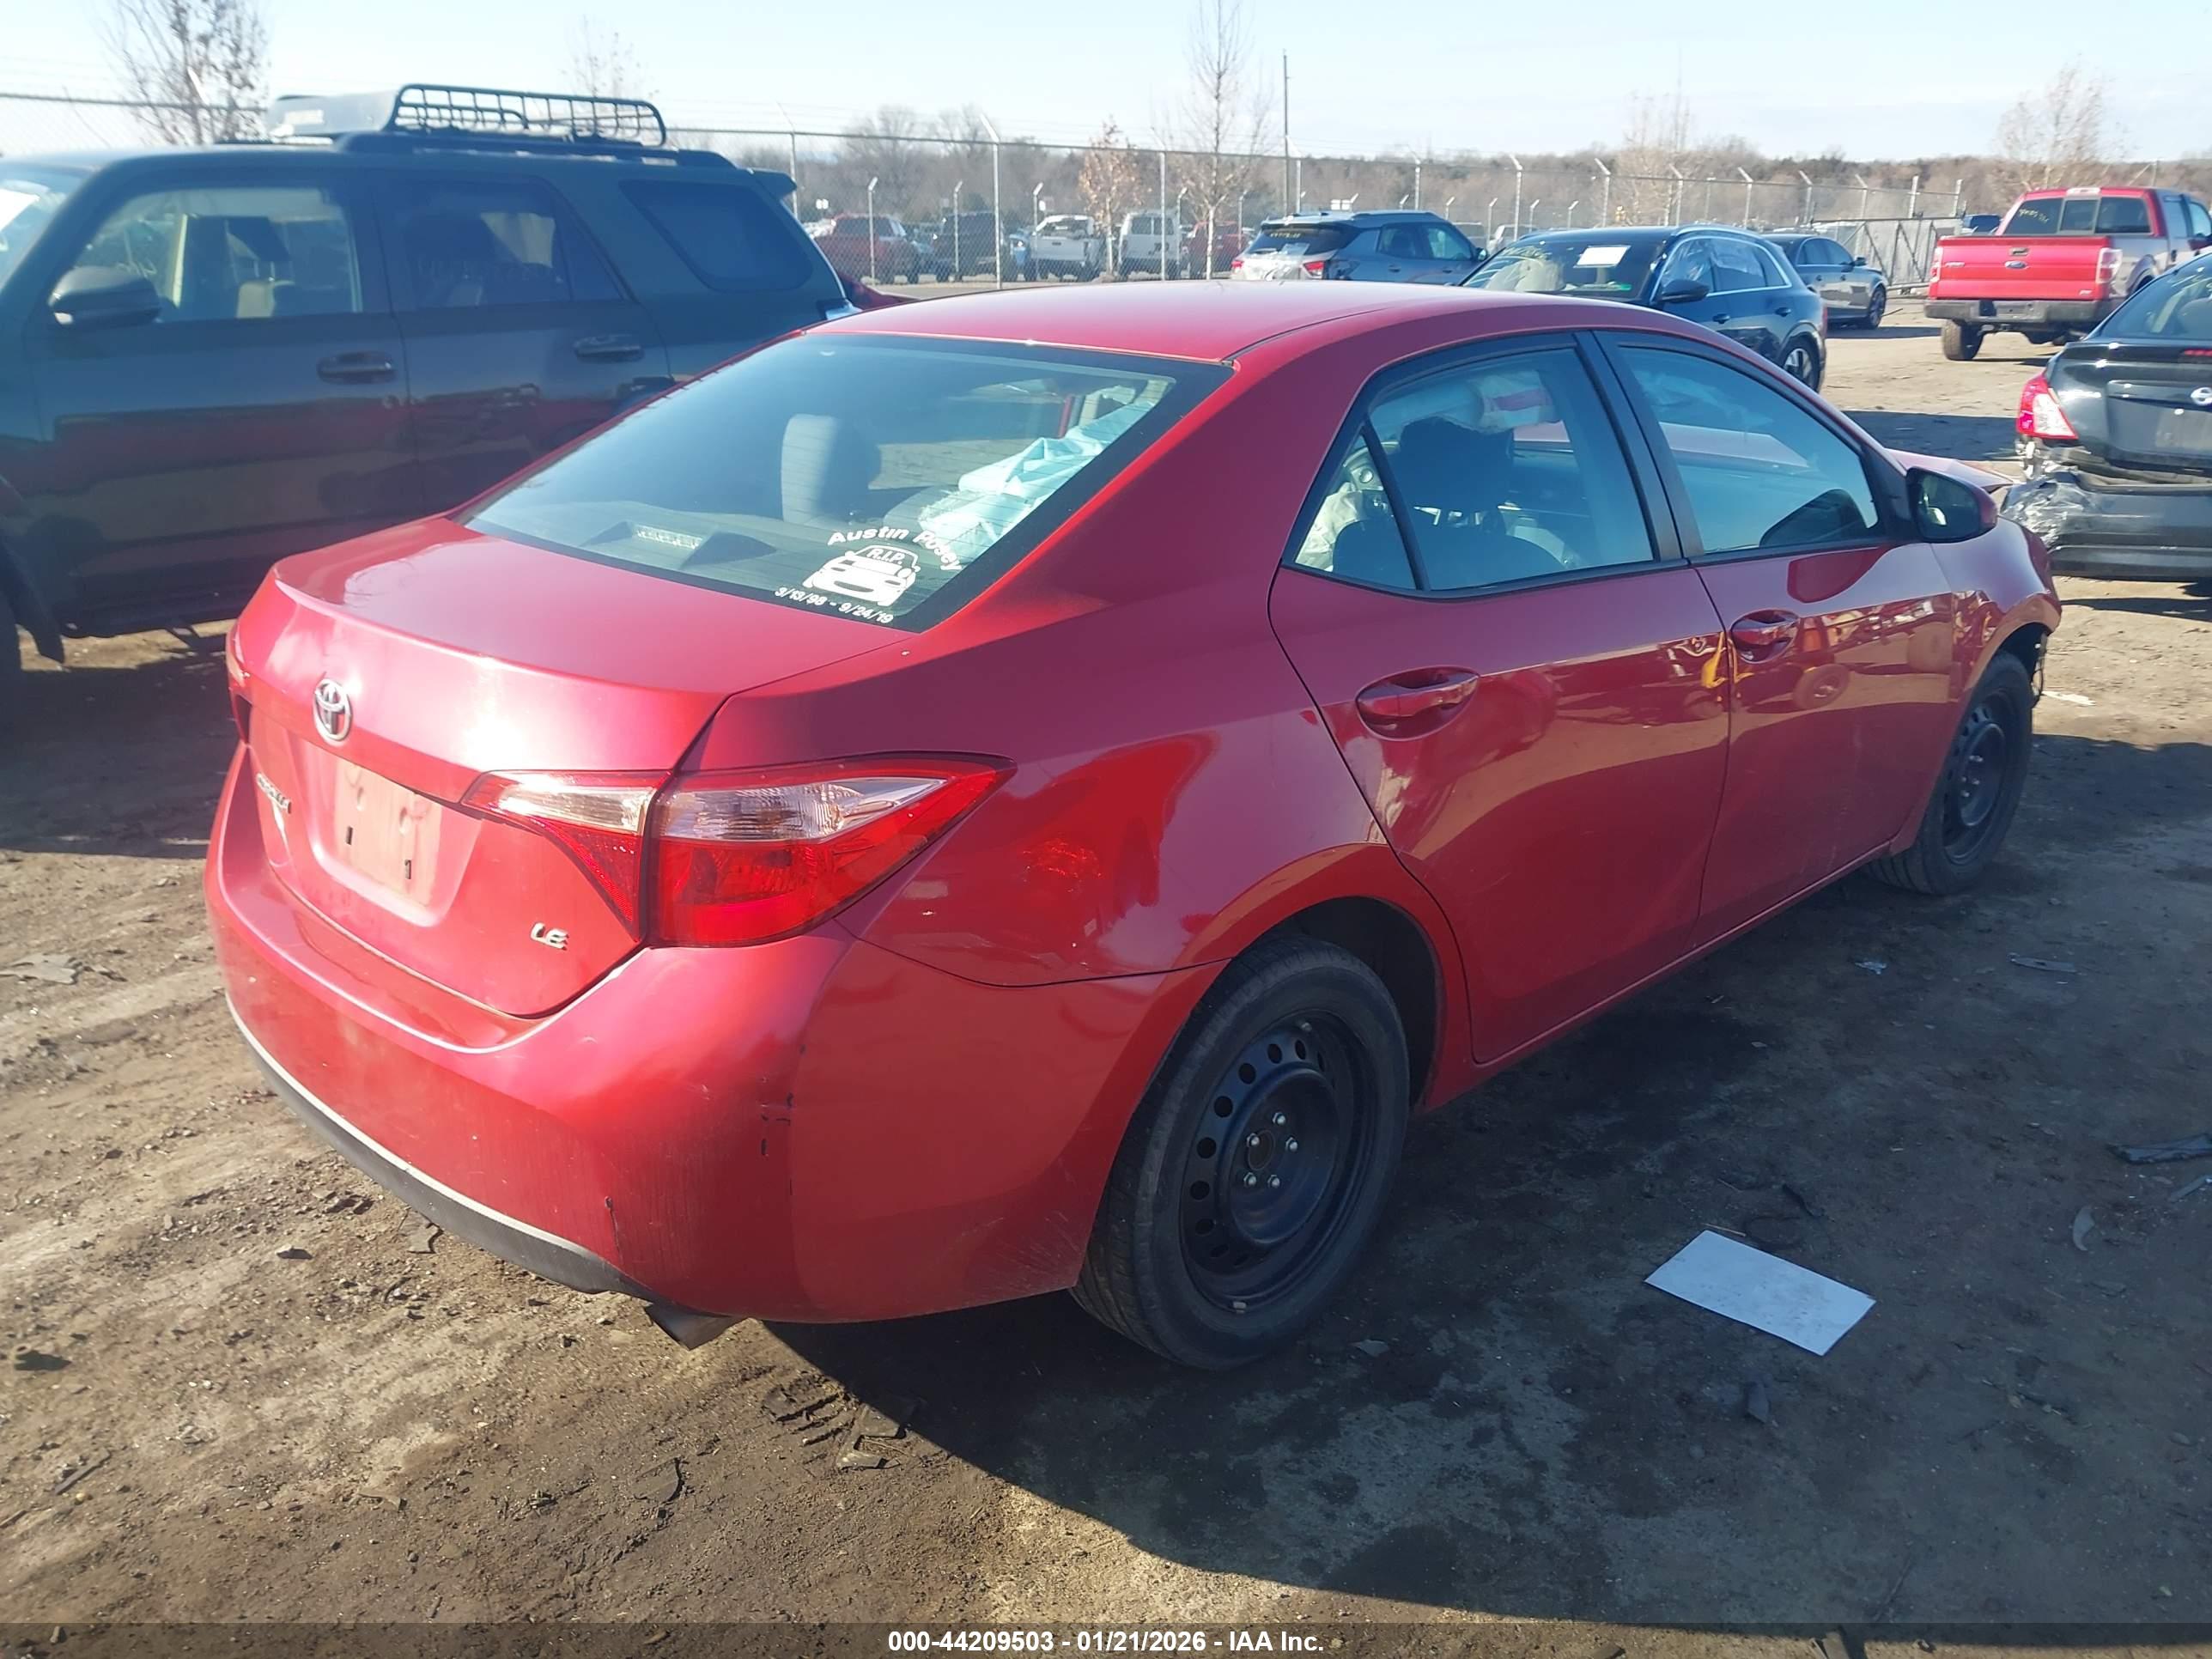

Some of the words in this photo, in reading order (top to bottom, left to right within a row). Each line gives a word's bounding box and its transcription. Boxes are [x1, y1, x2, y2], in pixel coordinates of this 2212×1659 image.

[827, 526, 909, 546] Austin
[866, 548, 906, 564] R.I.P.
[838, 602, 894, 623] 9/24/19
[530, 921, 568, 950] LE
